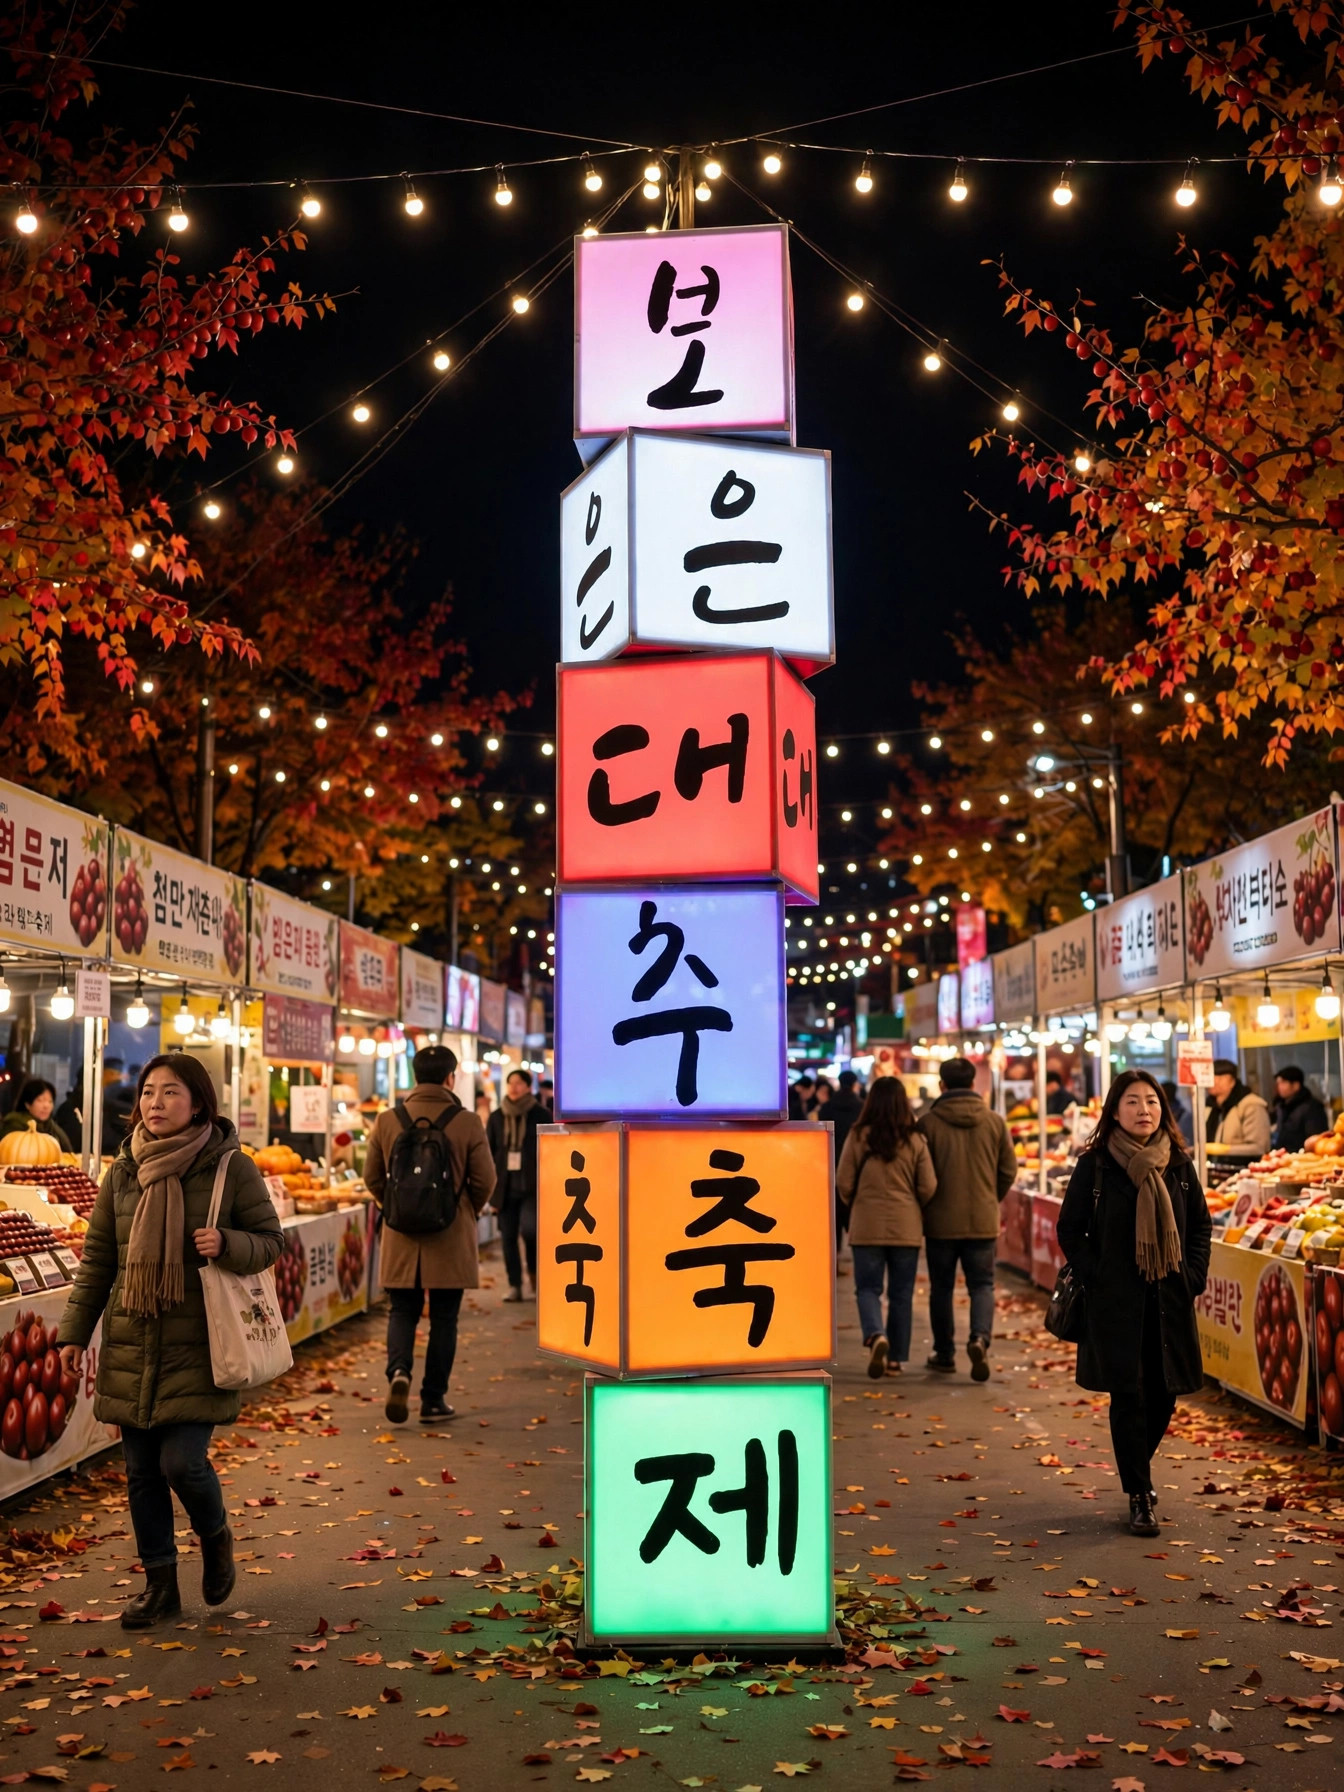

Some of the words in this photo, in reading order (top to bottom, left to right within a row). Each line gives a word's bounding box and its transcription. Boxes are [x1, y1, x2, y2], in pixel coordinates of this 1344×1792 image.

[647, 260, 724, 409] 보
[576, 491, 614, 650] 은
[683, 470, 790, 624] 은
[587, 712, 750, 826] 대
[782, 728, 813, 831] 대
[612, 901, 734, 1106] 추
[555, 1150, 603, 1347] 축
[664, 1149, 796, 1348] 축
[634, 1429, 799, 1576] 제
